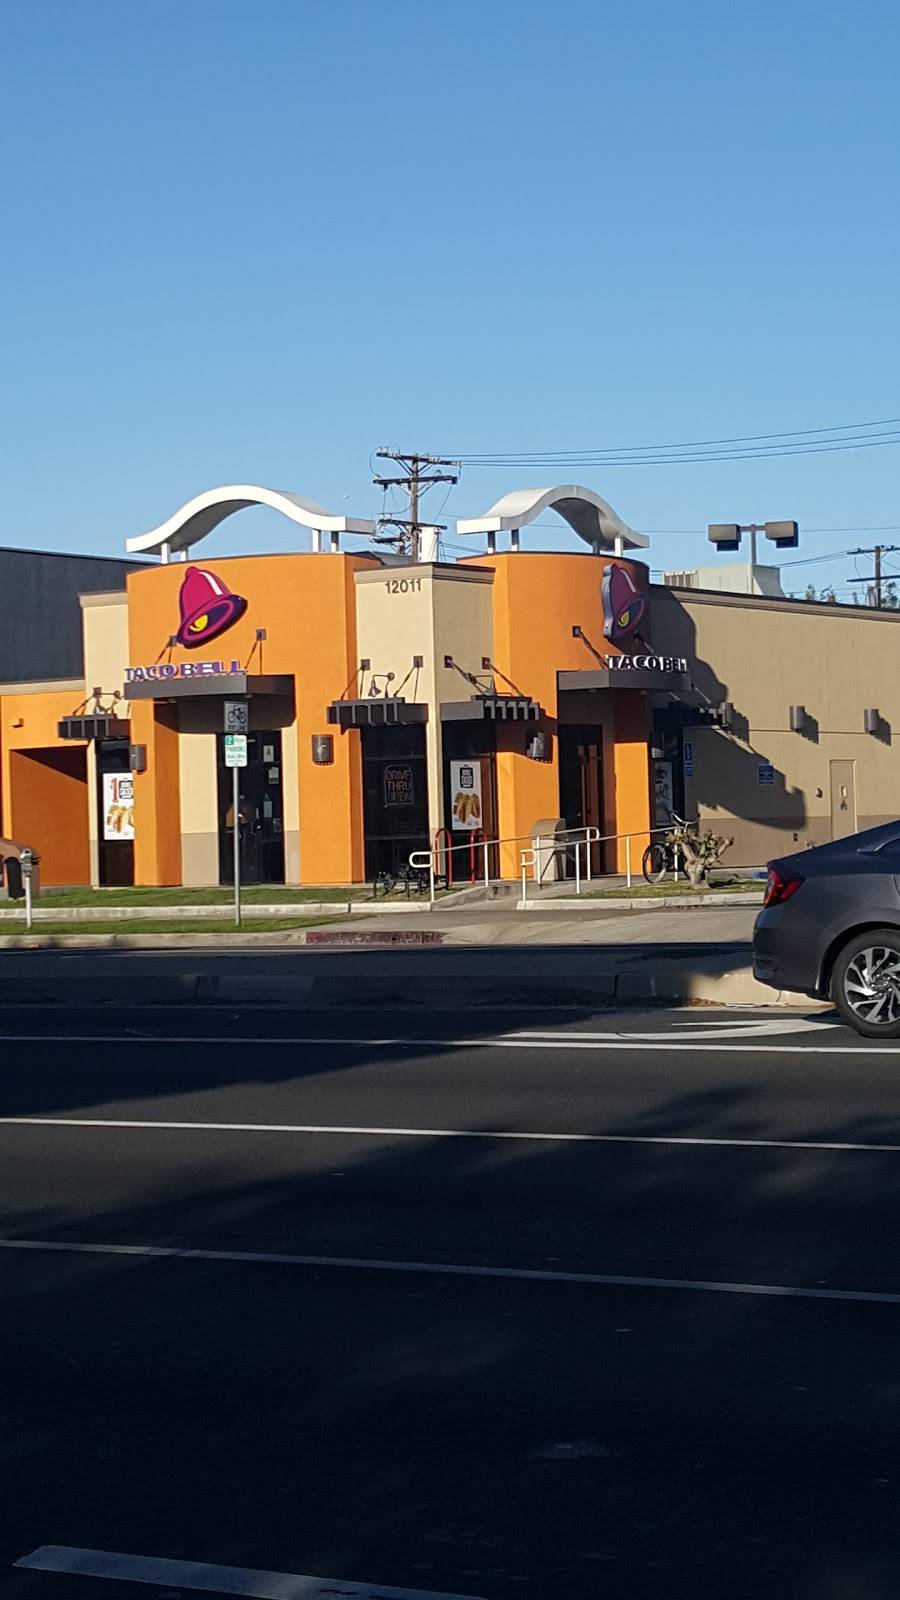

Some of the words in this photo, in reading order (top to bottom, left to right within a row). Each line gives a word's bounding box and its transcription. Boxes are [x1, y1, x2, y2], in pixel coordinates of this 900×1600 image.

[385, 578, 421, 594] 12011
[606, 654, 660, 671] TACO
[124, 663, 177, 682] TACO
[179, 660, 247, 679] BELL
[384, 769, 411, 781] DRIVE
[387, 781, 410, 792] THRU
